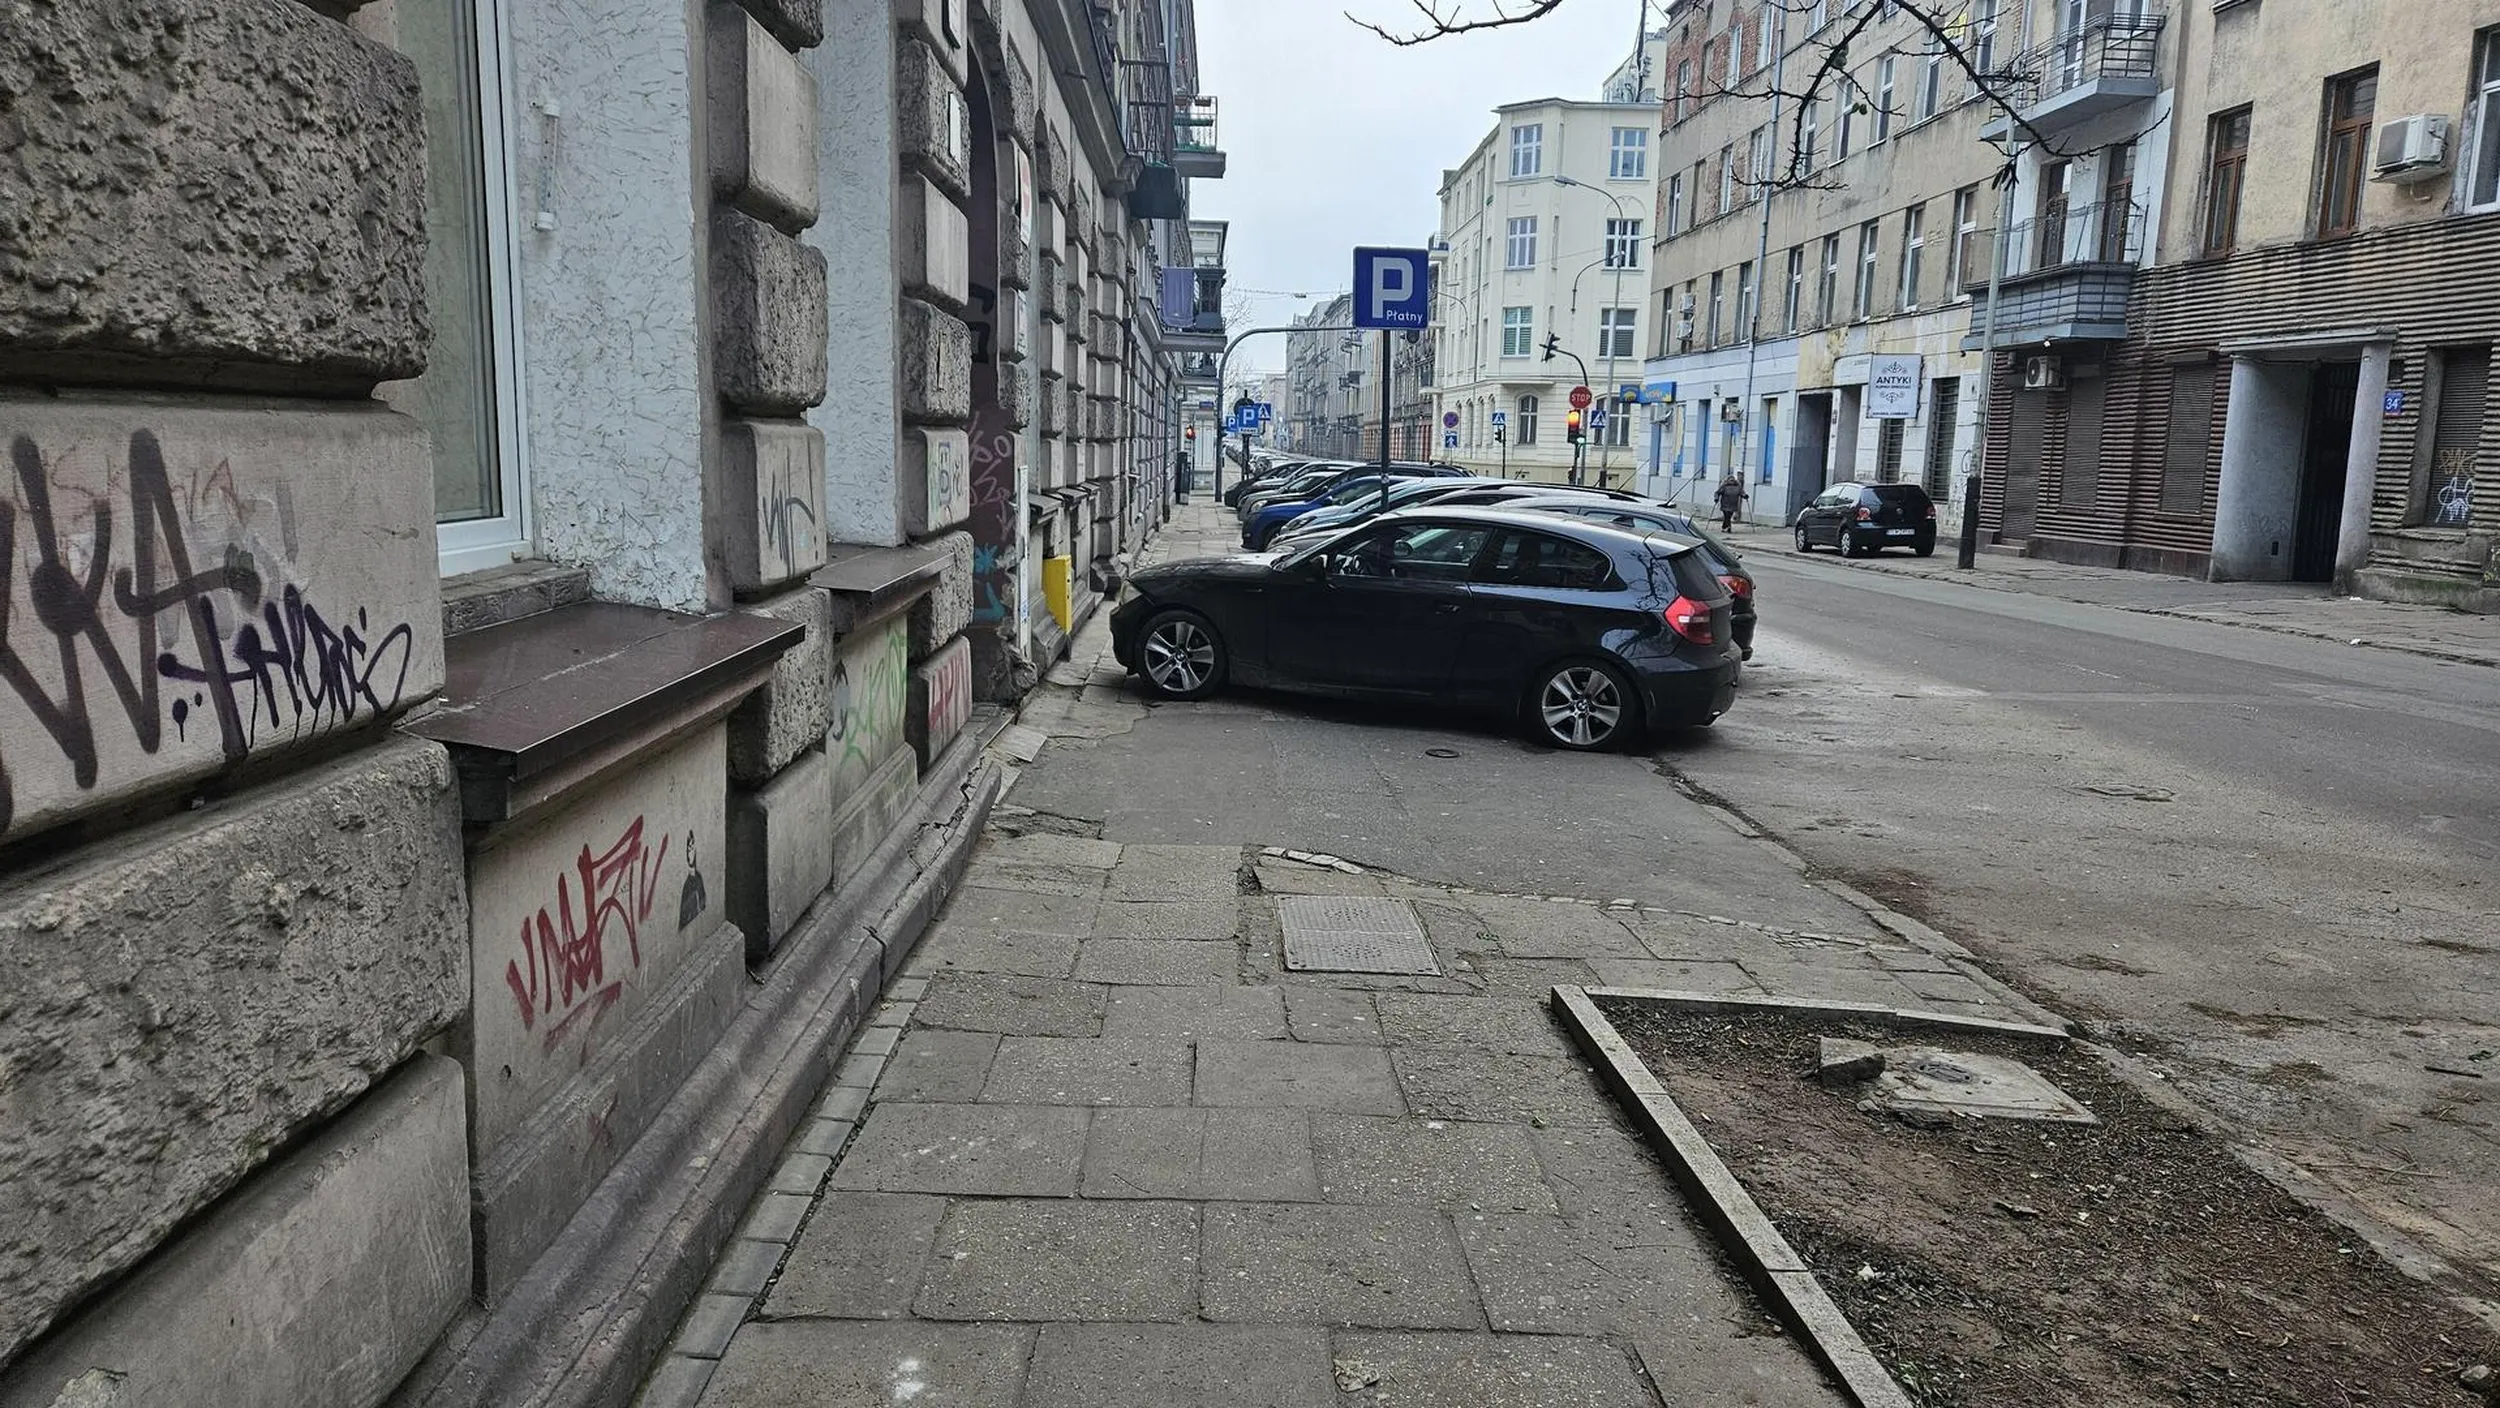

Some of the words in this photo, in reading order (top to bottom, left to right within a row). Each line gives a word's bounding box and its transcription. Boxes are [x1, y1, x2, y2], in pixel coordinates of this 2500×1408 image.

[1372, 257, 1413, 318] P
[1386, 309, 1423, 324] Płatny
[1876, 376, 1912, 384] ANTYKI
[1571, 393, 1591, 402] STOP
[2385, 398, 2398, 410] 34
[1228, 417, 1236, 428] P
[1243, 408, 1255, 425] P
